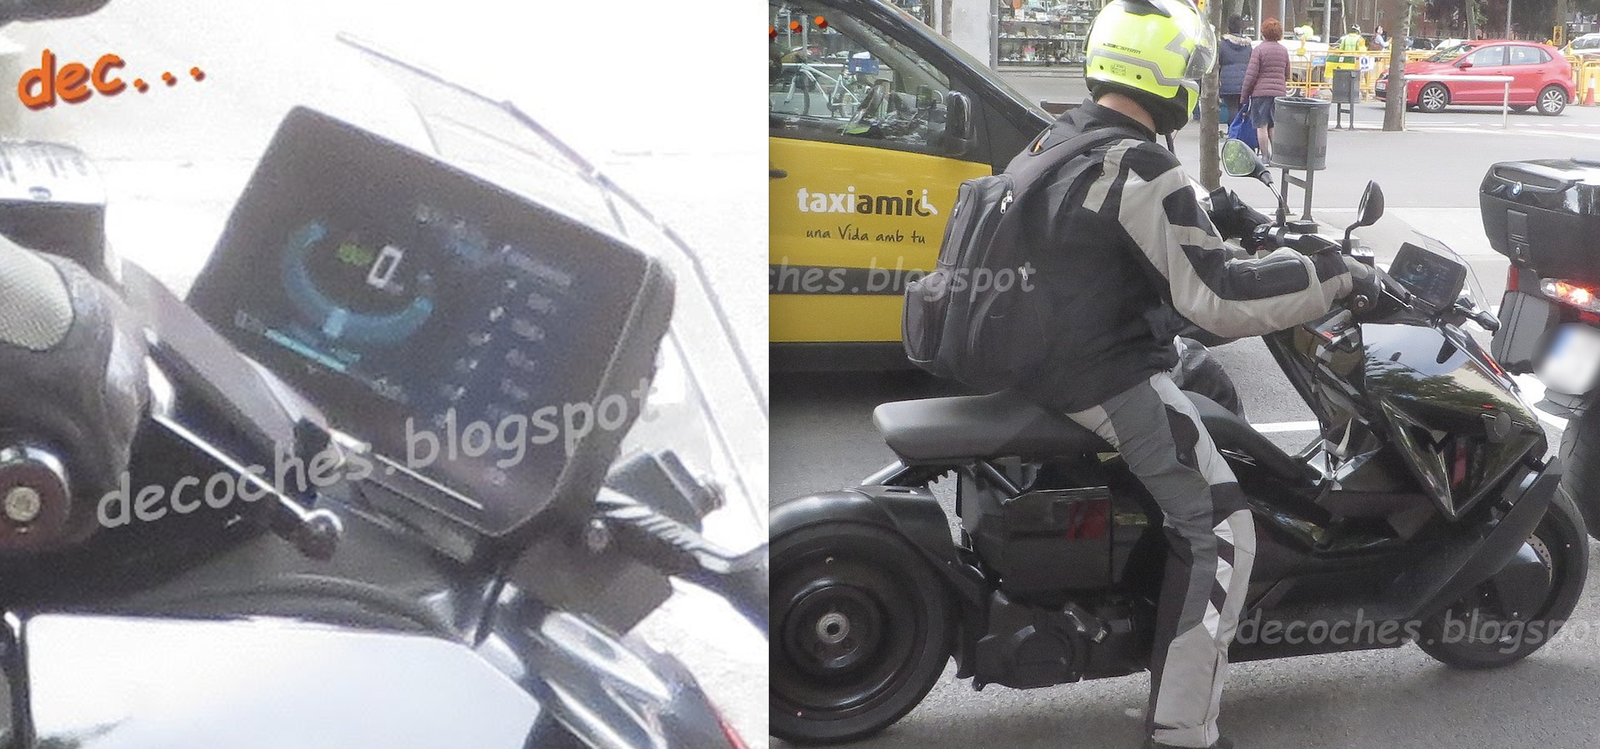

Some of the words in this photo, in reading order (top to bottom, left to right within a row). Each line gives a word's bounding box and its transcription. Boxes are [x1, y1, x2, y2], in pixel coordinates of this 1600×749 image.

[806, 228, 831, 239] una
[838, 223, 869, 241] Vida
[875, 229, 904, 242] amb
[911, 230, 926, 244] tu
